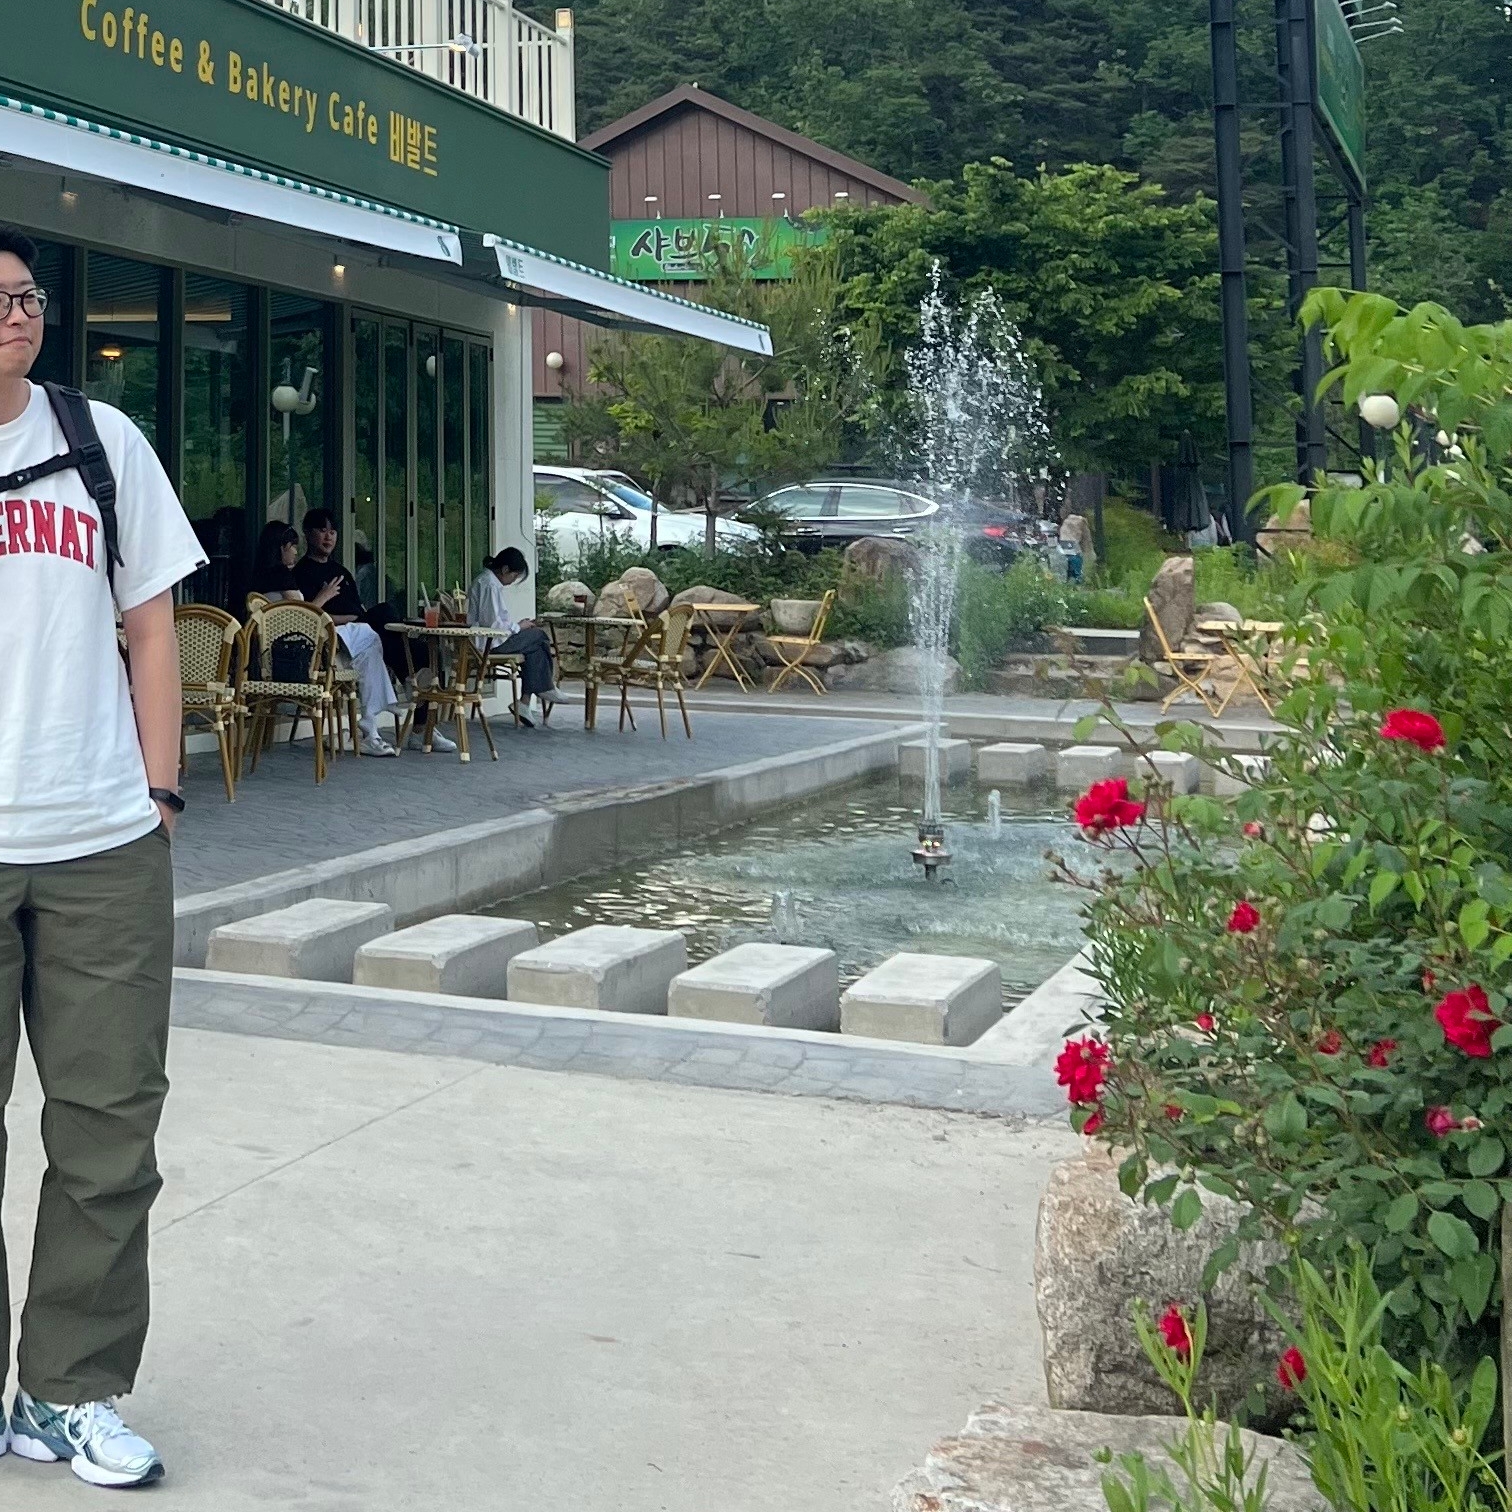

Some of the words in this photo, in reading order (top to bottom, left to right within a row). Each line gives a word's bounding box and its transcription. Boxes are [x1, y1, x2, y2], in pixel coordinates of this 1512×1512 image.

[197, 40, 215, 85] &
[228, 51, 318, 133] Bakery
[328, 92, 378, 144] Cafe
